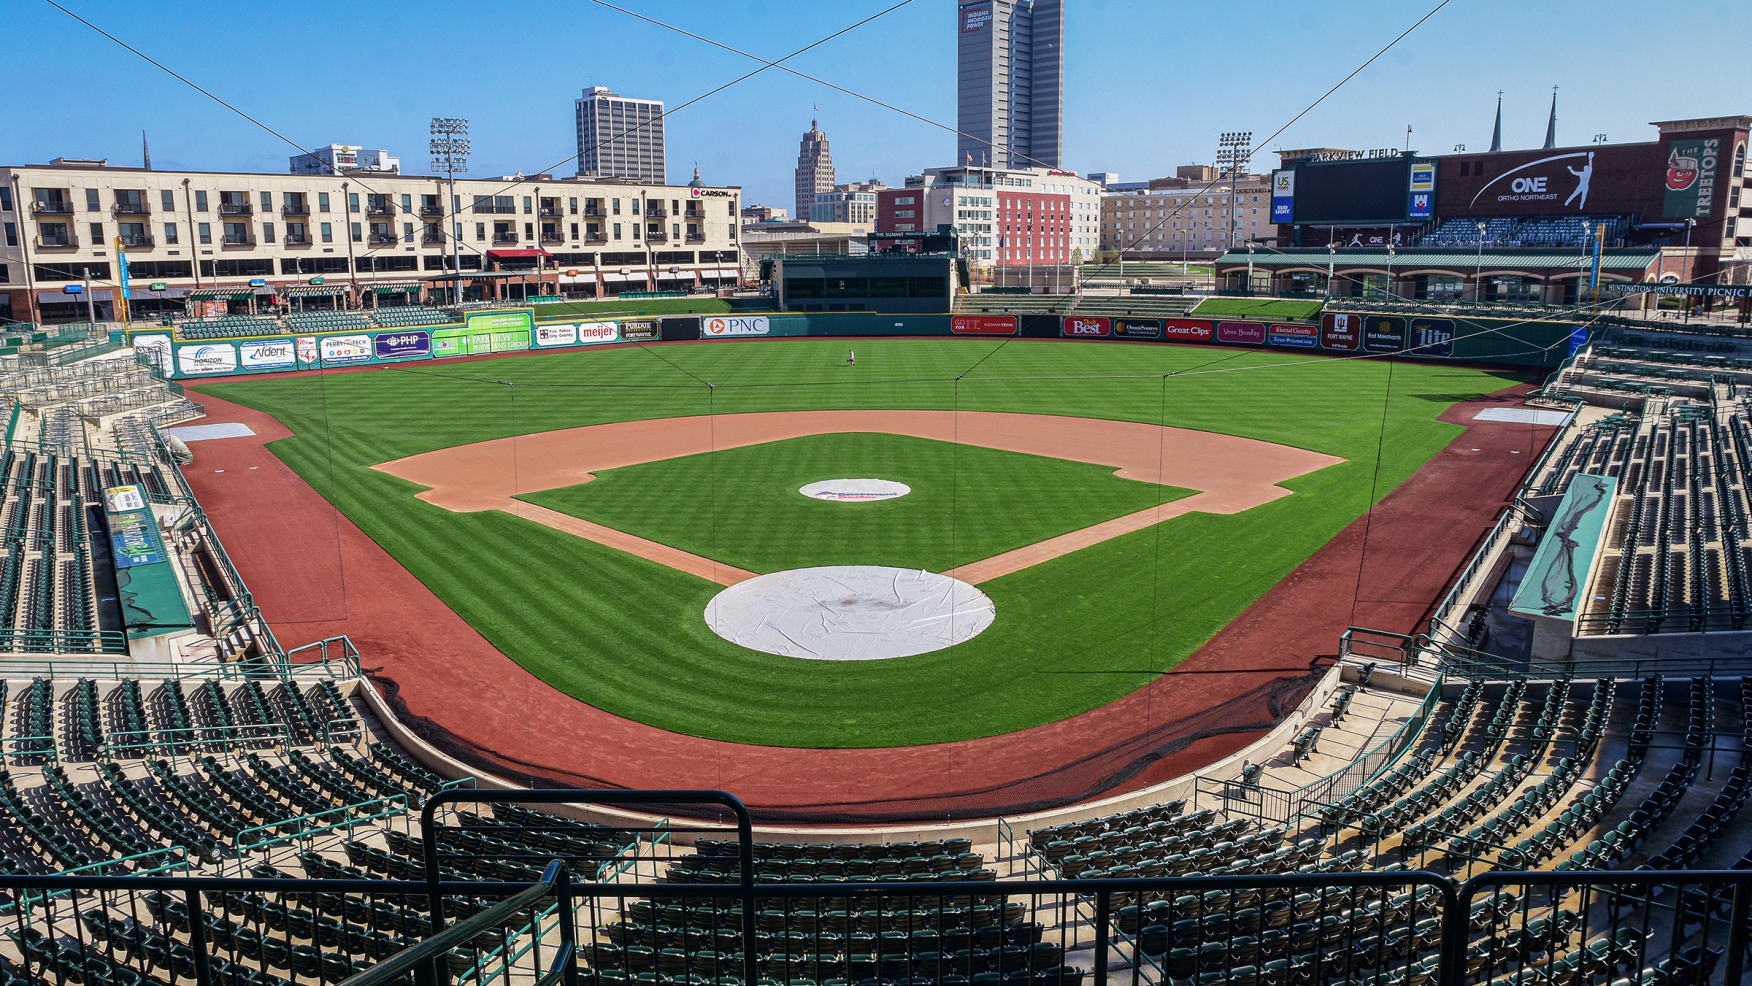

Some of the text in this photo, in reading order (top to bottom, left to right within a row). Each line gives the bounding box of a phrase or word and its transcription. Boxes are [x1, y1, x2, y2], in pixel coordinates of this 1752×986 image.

[967, 15, 992, 24] MICHIGAN
[968, 10, 989, 18] INDIANA
[1310, 148, 1398, 162] PARKVIEW FIELD
[1682, 146, 1699, 156] THE
[1695, 138, 1718, 216] TREETOPS
[1512, 176, 1548, 193] ONE
[1608, 284, 1651, 292] HUNTINGTON
[1654, 286, 1704, 296] UNIVERSITY
[1708, 289, 1744, 297] PICNIC
[730, 320, 764, 332] PNC
[1073, 320, 1101, 334] Best
[1167, 326, 1210, 336] Great Clips
[584, 326, 613, 339] meijer
[1239, 329, 1260, 338] Bradley
[400, 335, 418, 345] PHP
[254, 347, 286, 357] Afdent
